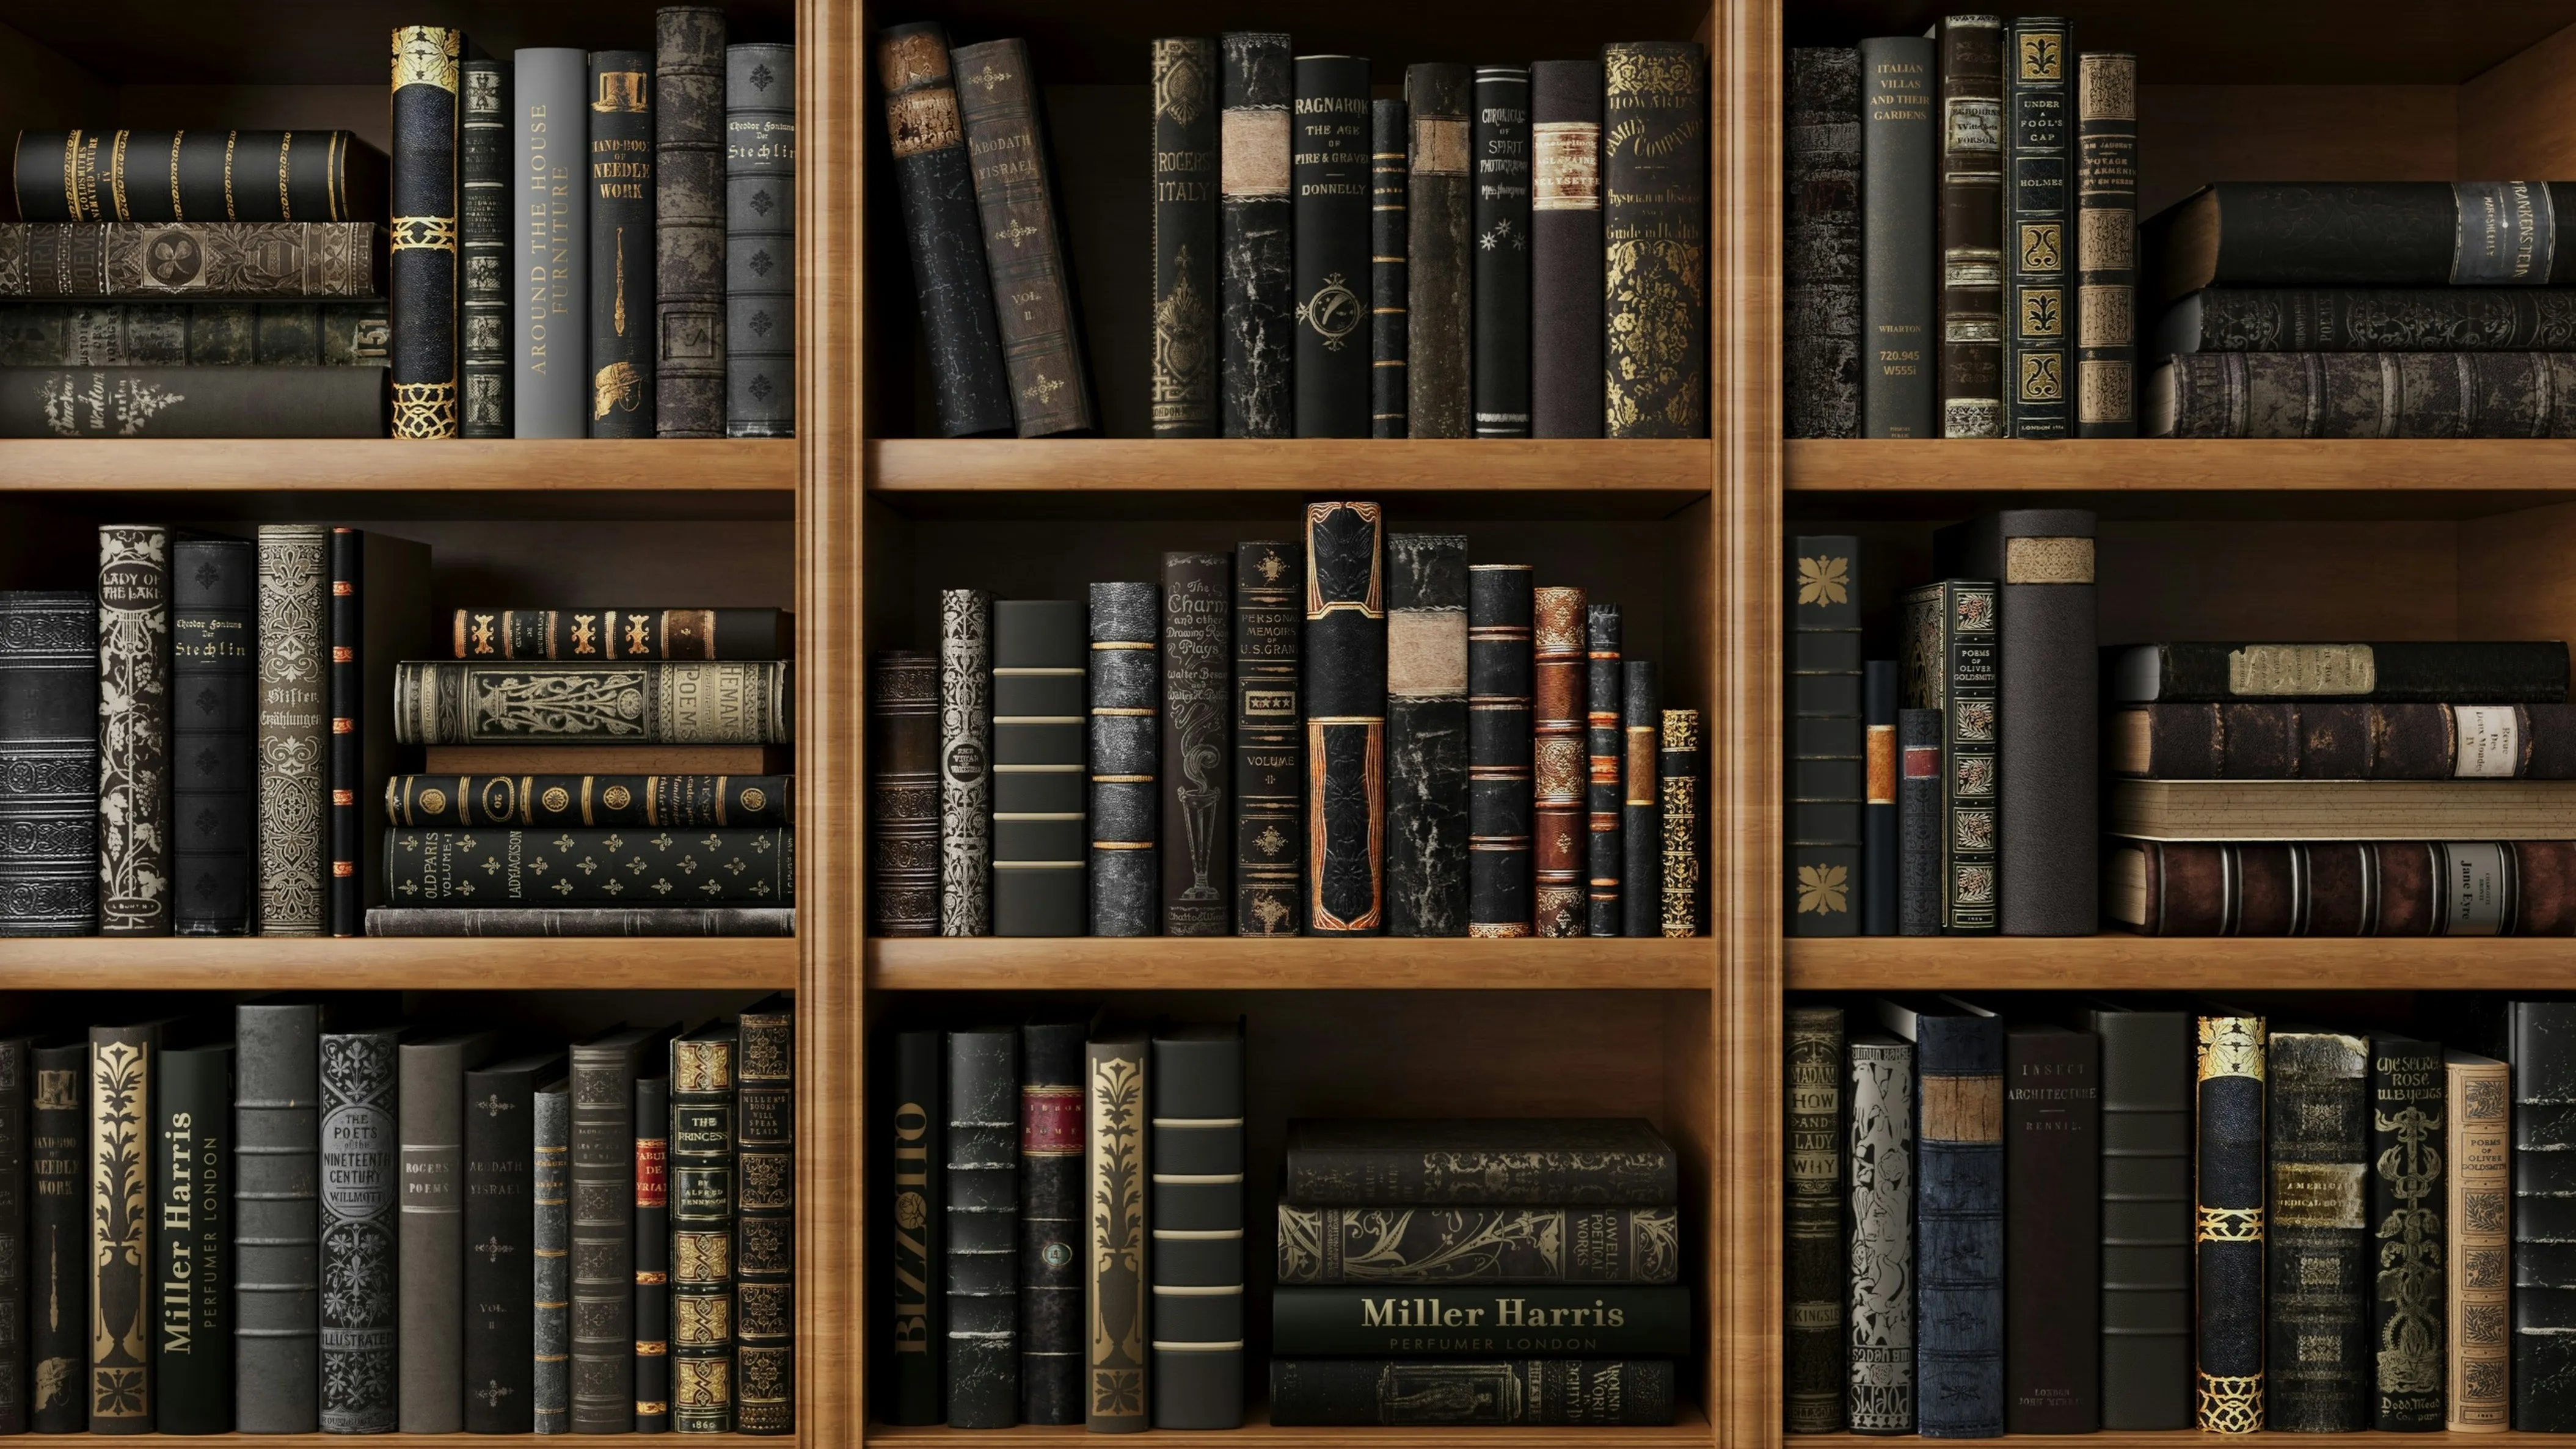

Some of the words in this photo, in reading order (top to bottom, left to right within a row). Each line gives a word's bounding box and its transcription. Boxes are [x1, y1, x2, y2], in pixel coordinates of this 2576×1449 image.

[1877, 64, 1924, 73] ITALIAN
[1881, 80, 1921, 89] VILLAS
[1870, 95, 1894, 105] AND
[1896, 95, 1930, 105] THEIR
[1874, 111, 1927, 120] GARDENS
[1305, 125, 1331, 136] THE
[1337, 125, 1360, 136] AGE
[531, 104, 547, 191] HOUSE
[1489, 140, 1523, 158] SPIRIT
[1294, 153, 1321, 165] FIRE
[600, 183, 643, 199] WORK
[1159, 181, 1211, 202] ITALY
[1302, 183, 1366, 196] DONNELLY
[531, 203, 547, 255] THE
[552, 167, 568, 315] FURNITURE
[531, 266, 547, 375] AROUND
[358, 319, 388, 357] 151
[1880, 351, 1919, 360] 720.945
[103, 573, 137, 586] LADY
[1187, 579, 1210, 593] The
[103, 587, 125, 600] THE
[1168, 594, 1228, 613] Charm
[1174, 615, 1193, 626] and
[1166, 626, 1205, 640] Drawing
[1247, 627, 1296, 636] MEMOIRS
[175, 642, 245, 657] Stechlin
[1179, 639, 1219, 659] Plays
[1167, 669, 1197, 679] Walter
[677, 663, 701, 740] POEMS
[720, 663, 742, 741] HEMANS
[2476, 711, 2484, 735] Deux
[2466, 736, 2474, 746] IV
[1247, 756, 1294, 767] VOLUME
[494, 794, 503, 809] 20
[424, 832, 438, 872] PARIS
[2461, 860, 2472, 889] Jane
[425, 875, 437, 899] OLD
[2461, 893, 2473, 920] Eyre
[1790, 1067, 1835, 1084] MADAM
[1792, 1093, 1834, 1108] HOW
[2008, 1088, 2097, 1100] ARCHITECTURE
[345, 1115, 368, 1124] THE
[1800, 1117, 1828, 1128] AND
[335, 1127, 378, 1139] POETS
[1026, 1126, 1078, 1136] ROME
[1795, 1134, 1834, 1150] LADY
[324, 1153, 391, 1167] NINETEENTH
[1793, 1159, 1834, 1174] WHY
[164, 1112, 192, 1231] Harris
[330, 1170, 383, 1184] CENTURY
[646, 1166, 663, 1175] DE
[204, 1137, 217, 1221] LONDON
[38, 1180, 73, 1195] WORK
[409, 1183, 449, 1193] POEMS
[1573, 1218, 1588, 1266] WORKS
[1591, 1214, 1603, 1272] POETICAL
[1605, 1208, 1618, 1280] LOWELL'S
[204, 1232, 217, 1328] PERFUMER
[164, 1241, 191, 1355] Miller
[1361, 1299, 1484, 1327] Miller
[1495, 1299, 1625, 1327] Harris
[323, 1332, 393, 1346] ILLUSTRATED
[1391, 1338, 1494, 1350] PERFUMER
[1506, 1338, 1596, 1350] LONDON
